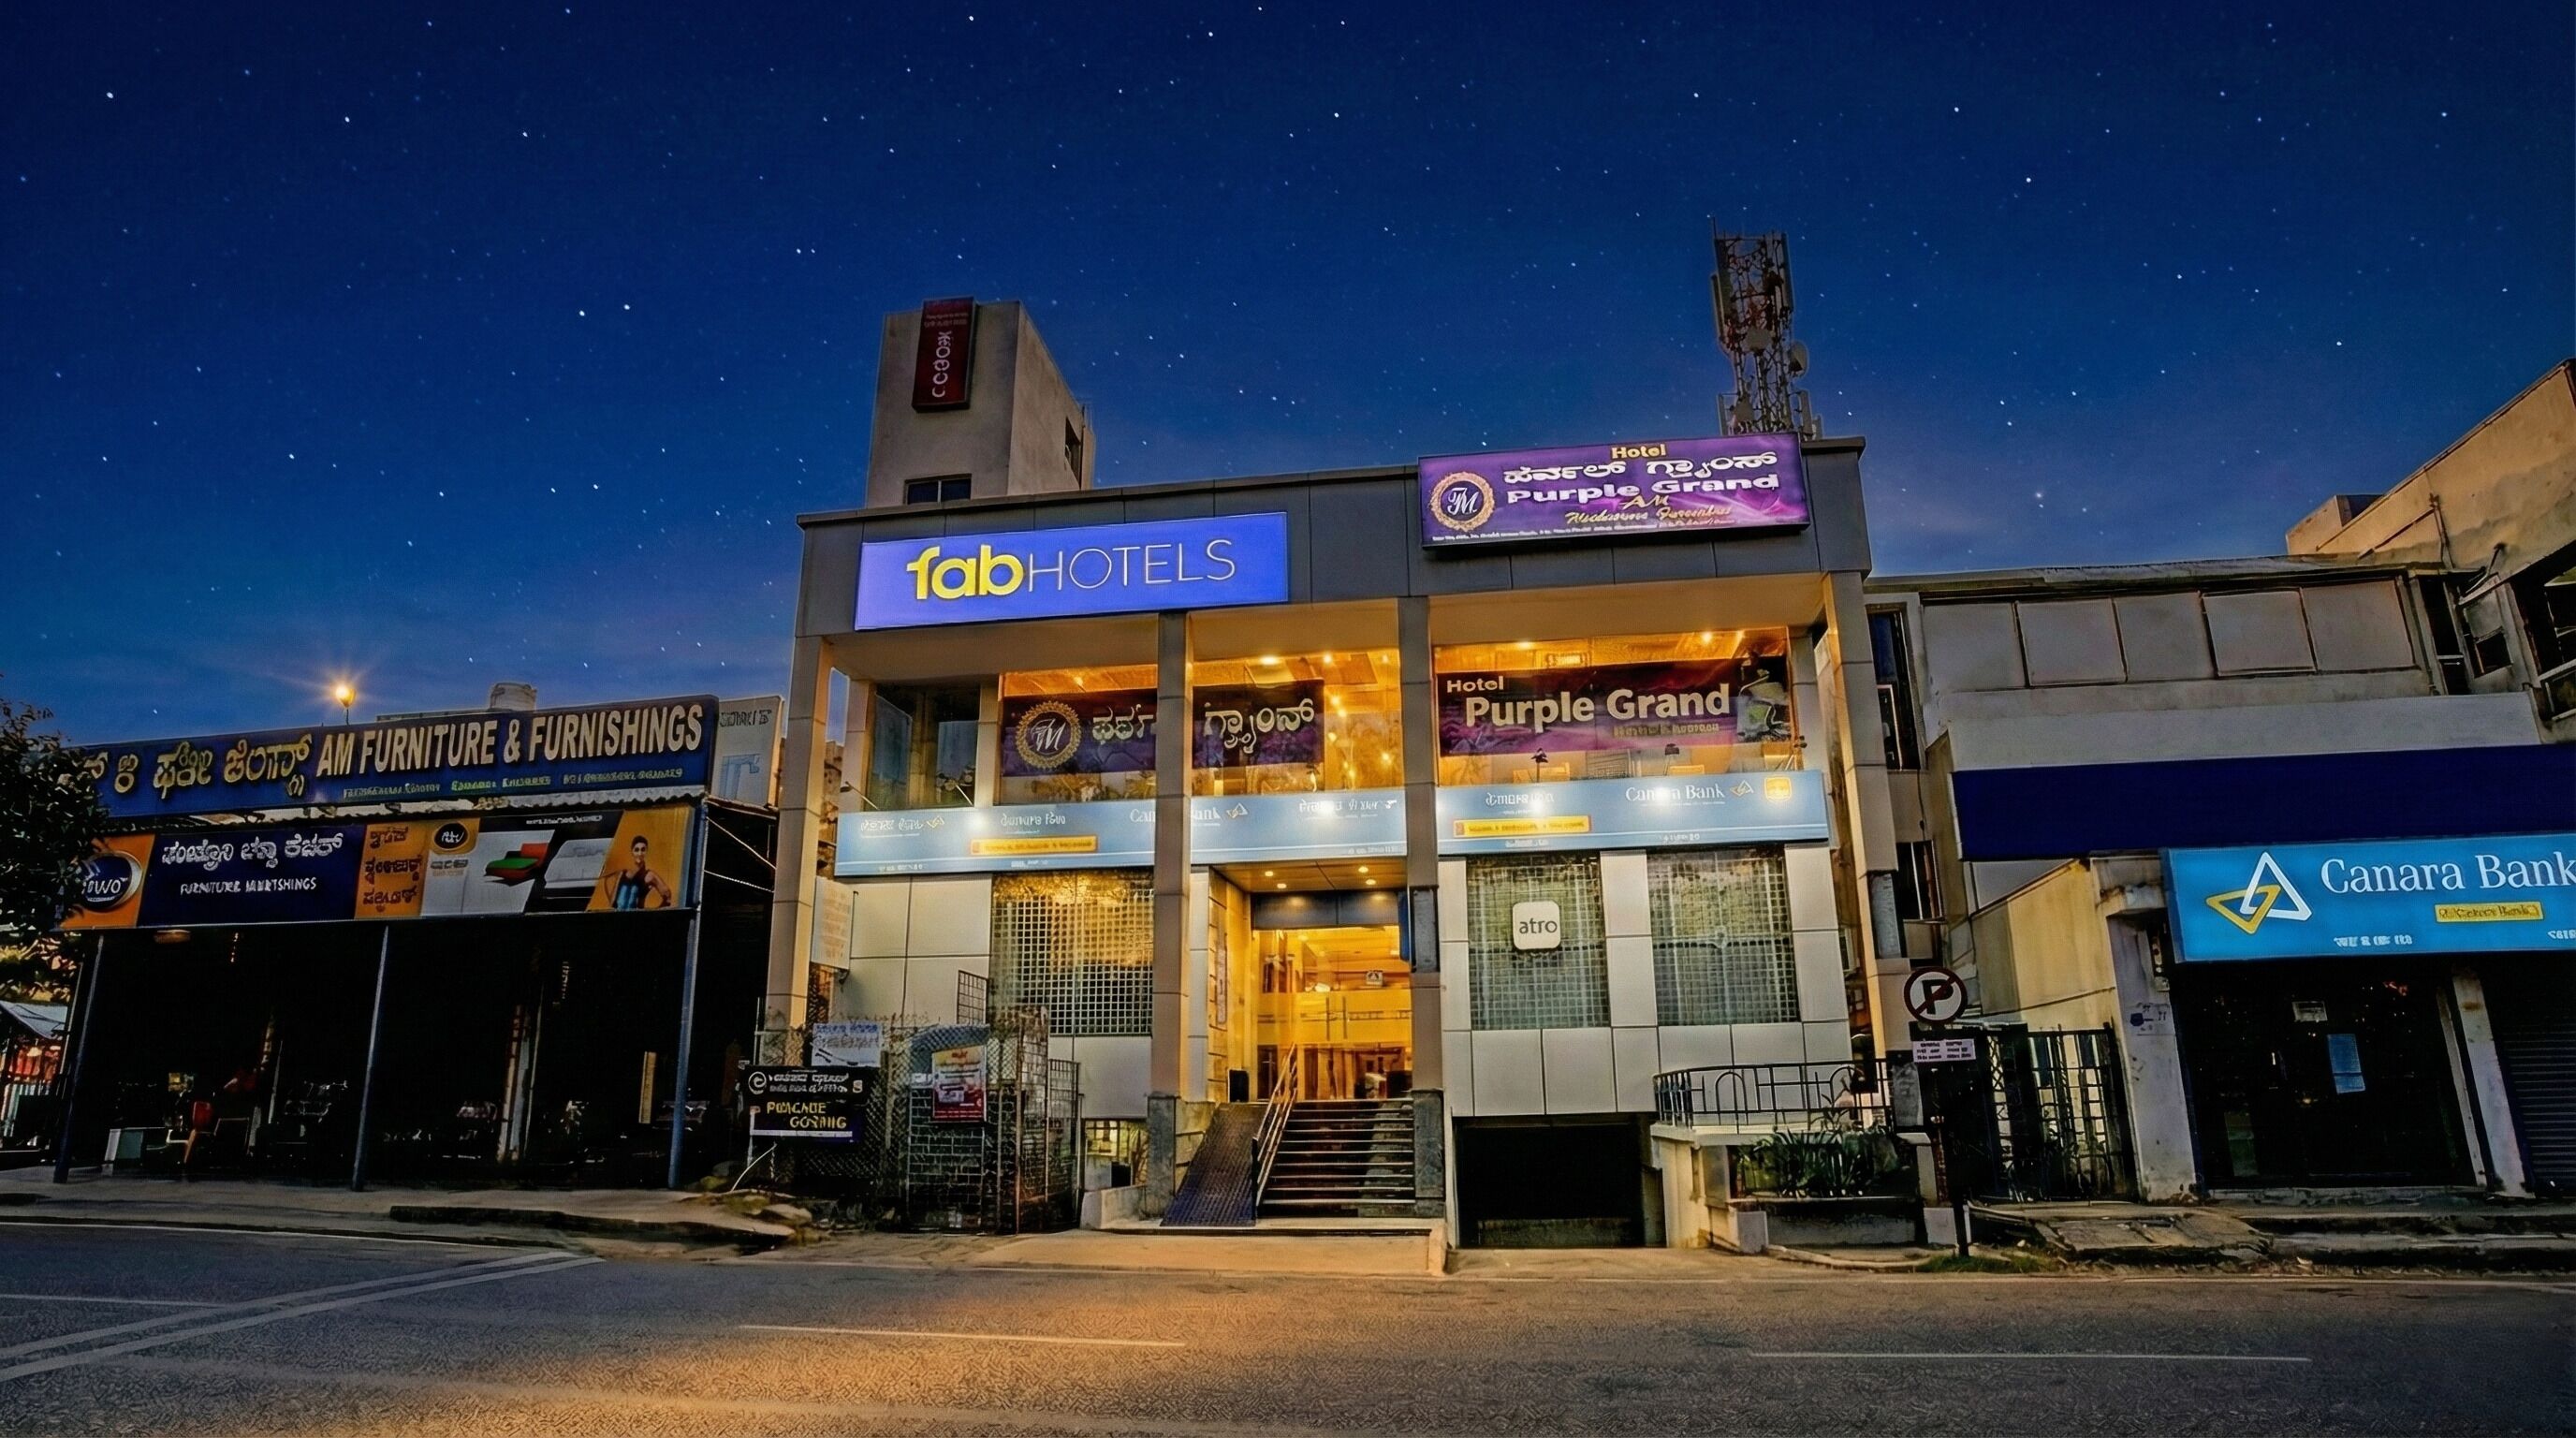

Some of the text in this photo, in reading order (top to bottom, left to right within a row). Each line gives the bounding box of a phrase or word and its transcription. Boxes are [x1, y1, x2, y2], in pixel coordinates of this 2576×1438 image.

[1611, 444, 1667, 461] Hotel
[1507, 474, 1779, 504] Purple Grand
[1446, 676, 1504, 694] Hotel
[1465, 691, 1595, 733] Purple
[1606, 683, 1730, 720] Grand
[315, 704, 704, 777] AM FURNITURE & FURNISHINGS
[1685, 783, 1726, 800] Bank
[1193, 807, 1221, 821] ank
[2320, 851, 2576, 894] Canara Bank
[1518, 917, 1558, 934] atro
[1922, 979, 1954, 1015] P
